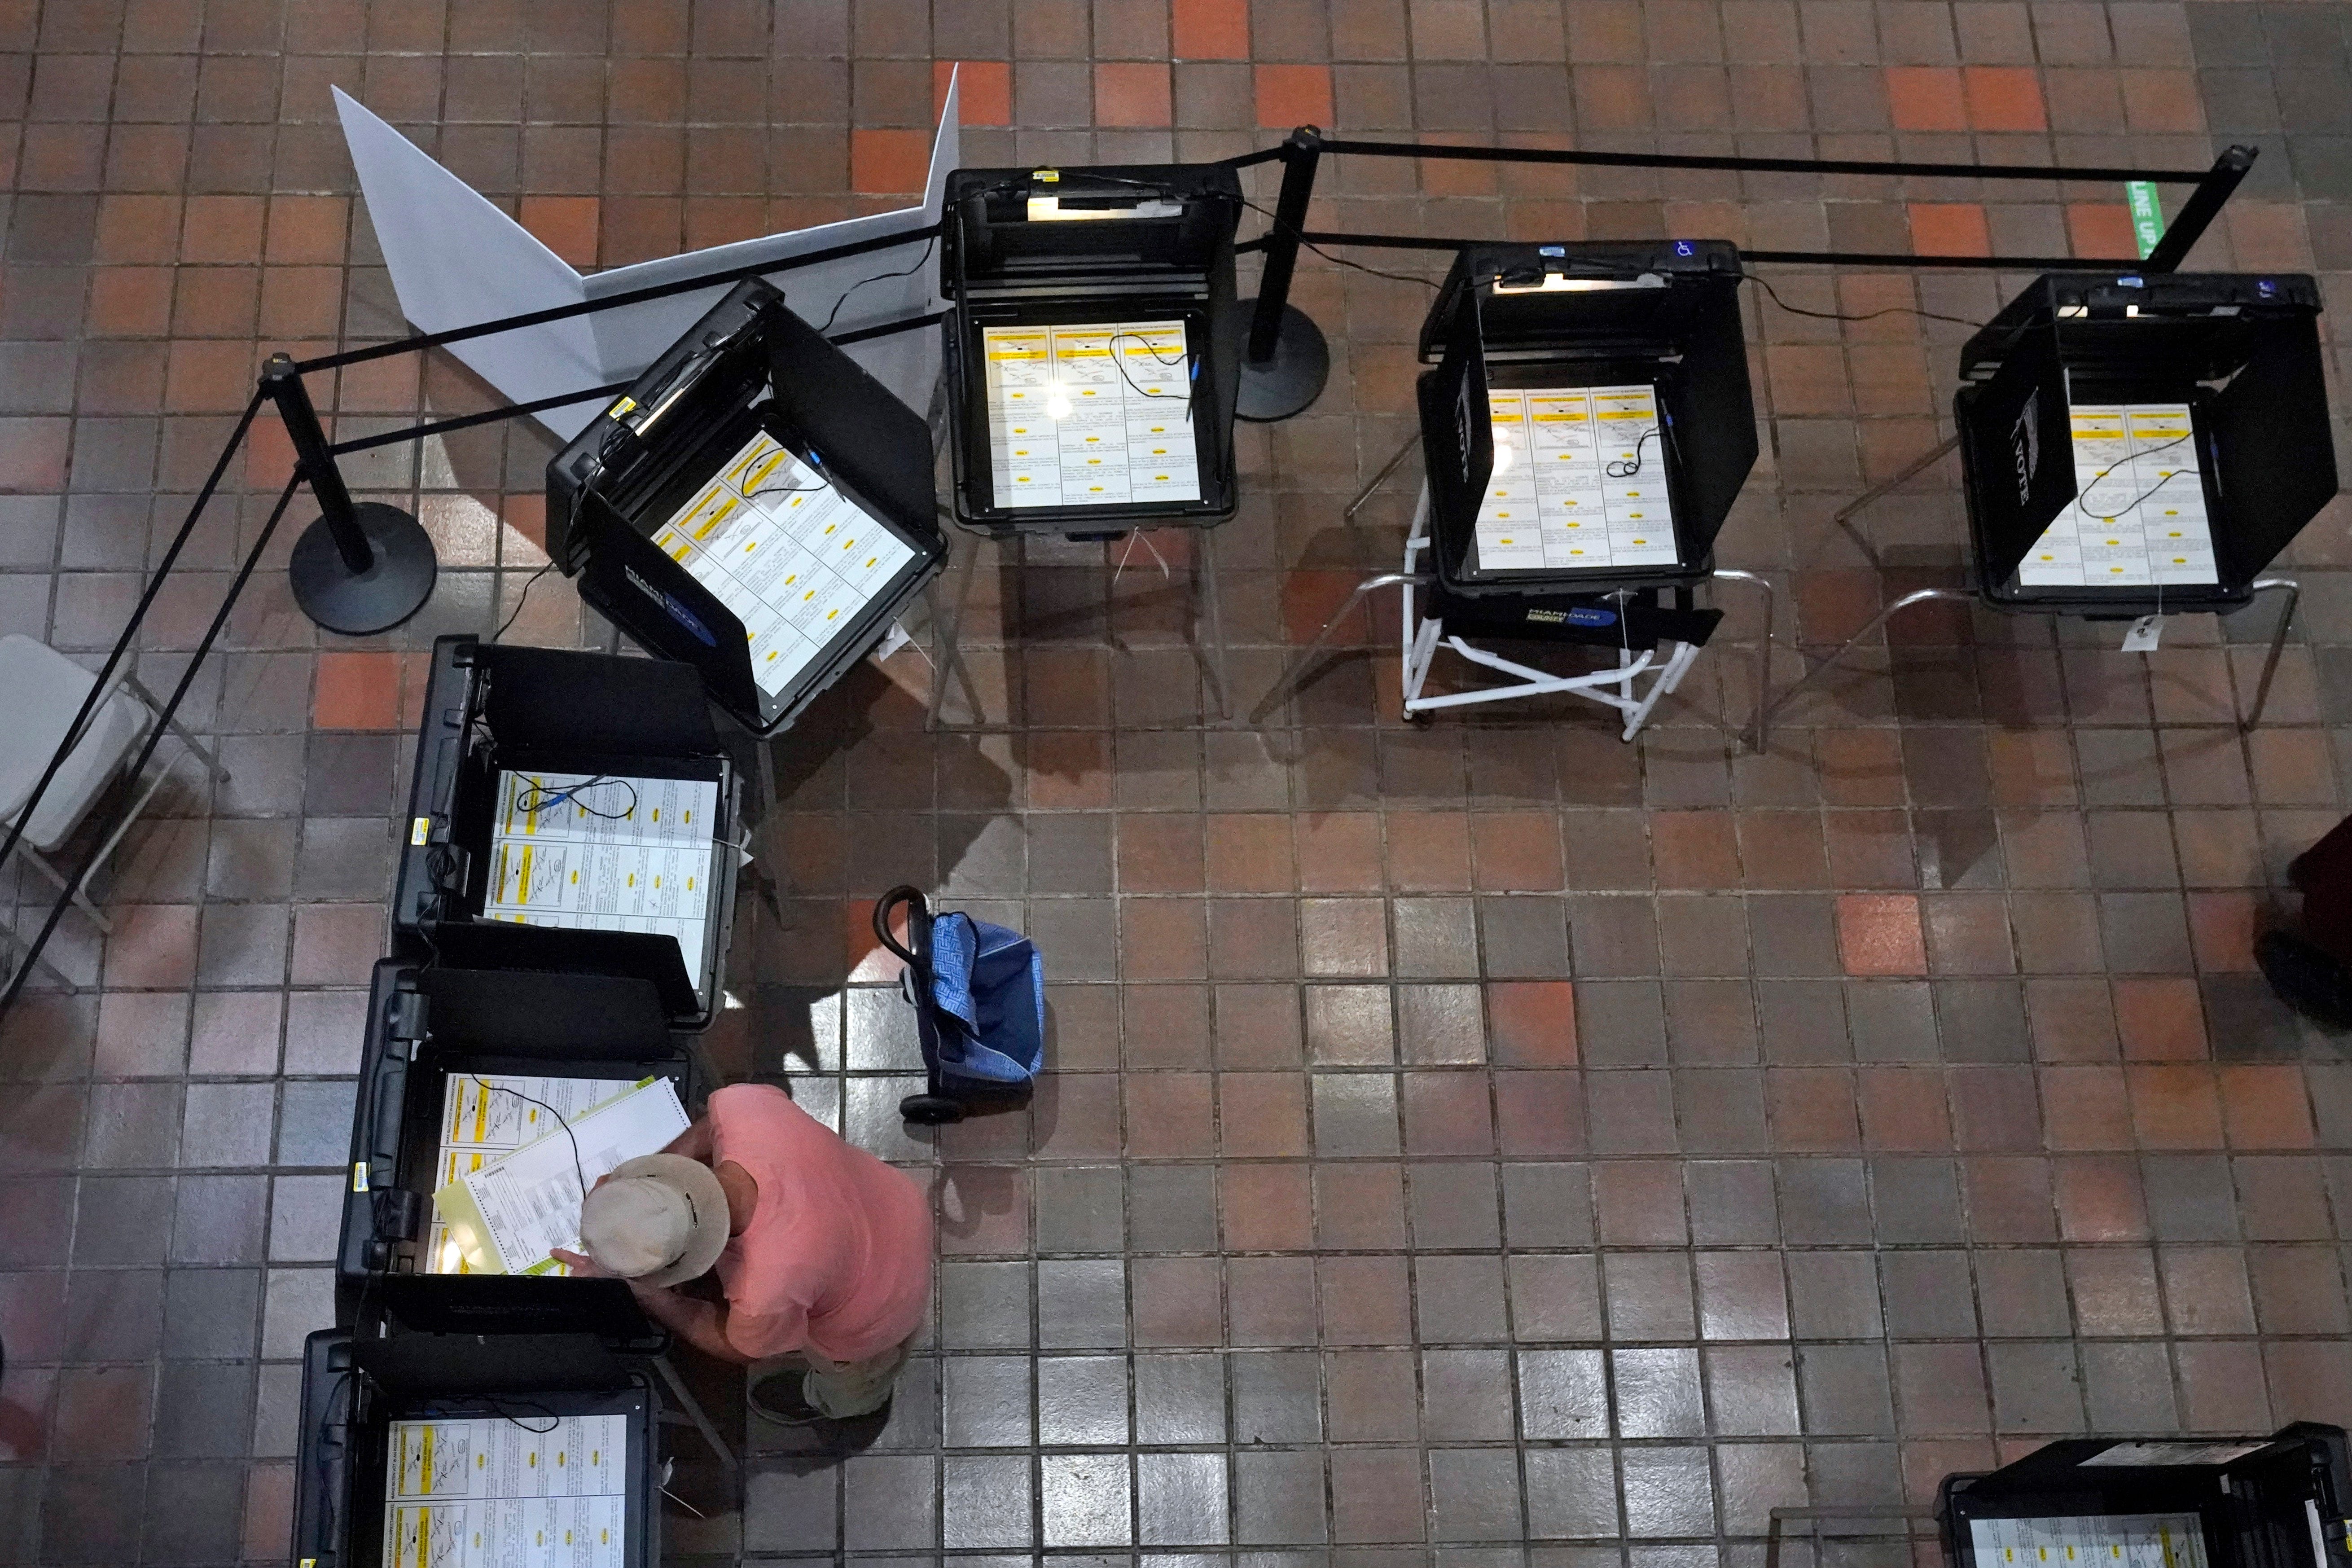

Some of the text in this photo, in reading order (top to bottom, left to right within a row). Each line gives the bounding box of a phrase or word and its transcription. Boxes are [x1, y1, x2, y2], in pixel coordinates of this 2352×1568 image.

[2131, 180, 2152, 217] LINE
[2139, 222, 2156, 245] UP
[2016, 438, 2029, 506] VOTE
